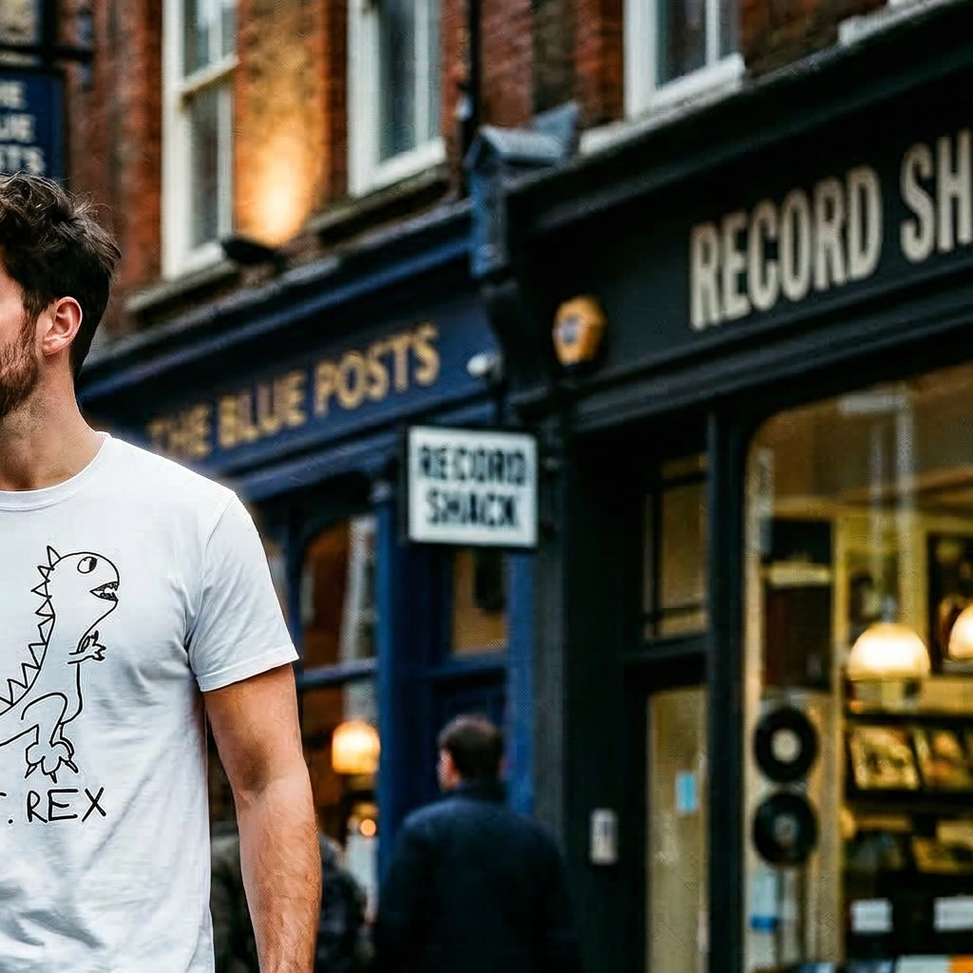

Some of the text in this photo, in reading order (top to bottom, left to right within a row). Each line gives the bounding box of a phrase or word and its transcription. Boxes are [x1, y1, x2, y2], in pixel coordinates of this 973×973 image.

[690, 129, 973, 331] RECORD SH
[218, 370, 308, 449] BLUE
[316, 323, 440, 415] POSTS
[419, 446, 525, 485] RECORD
[428, 489, 517, 527] SHACK
